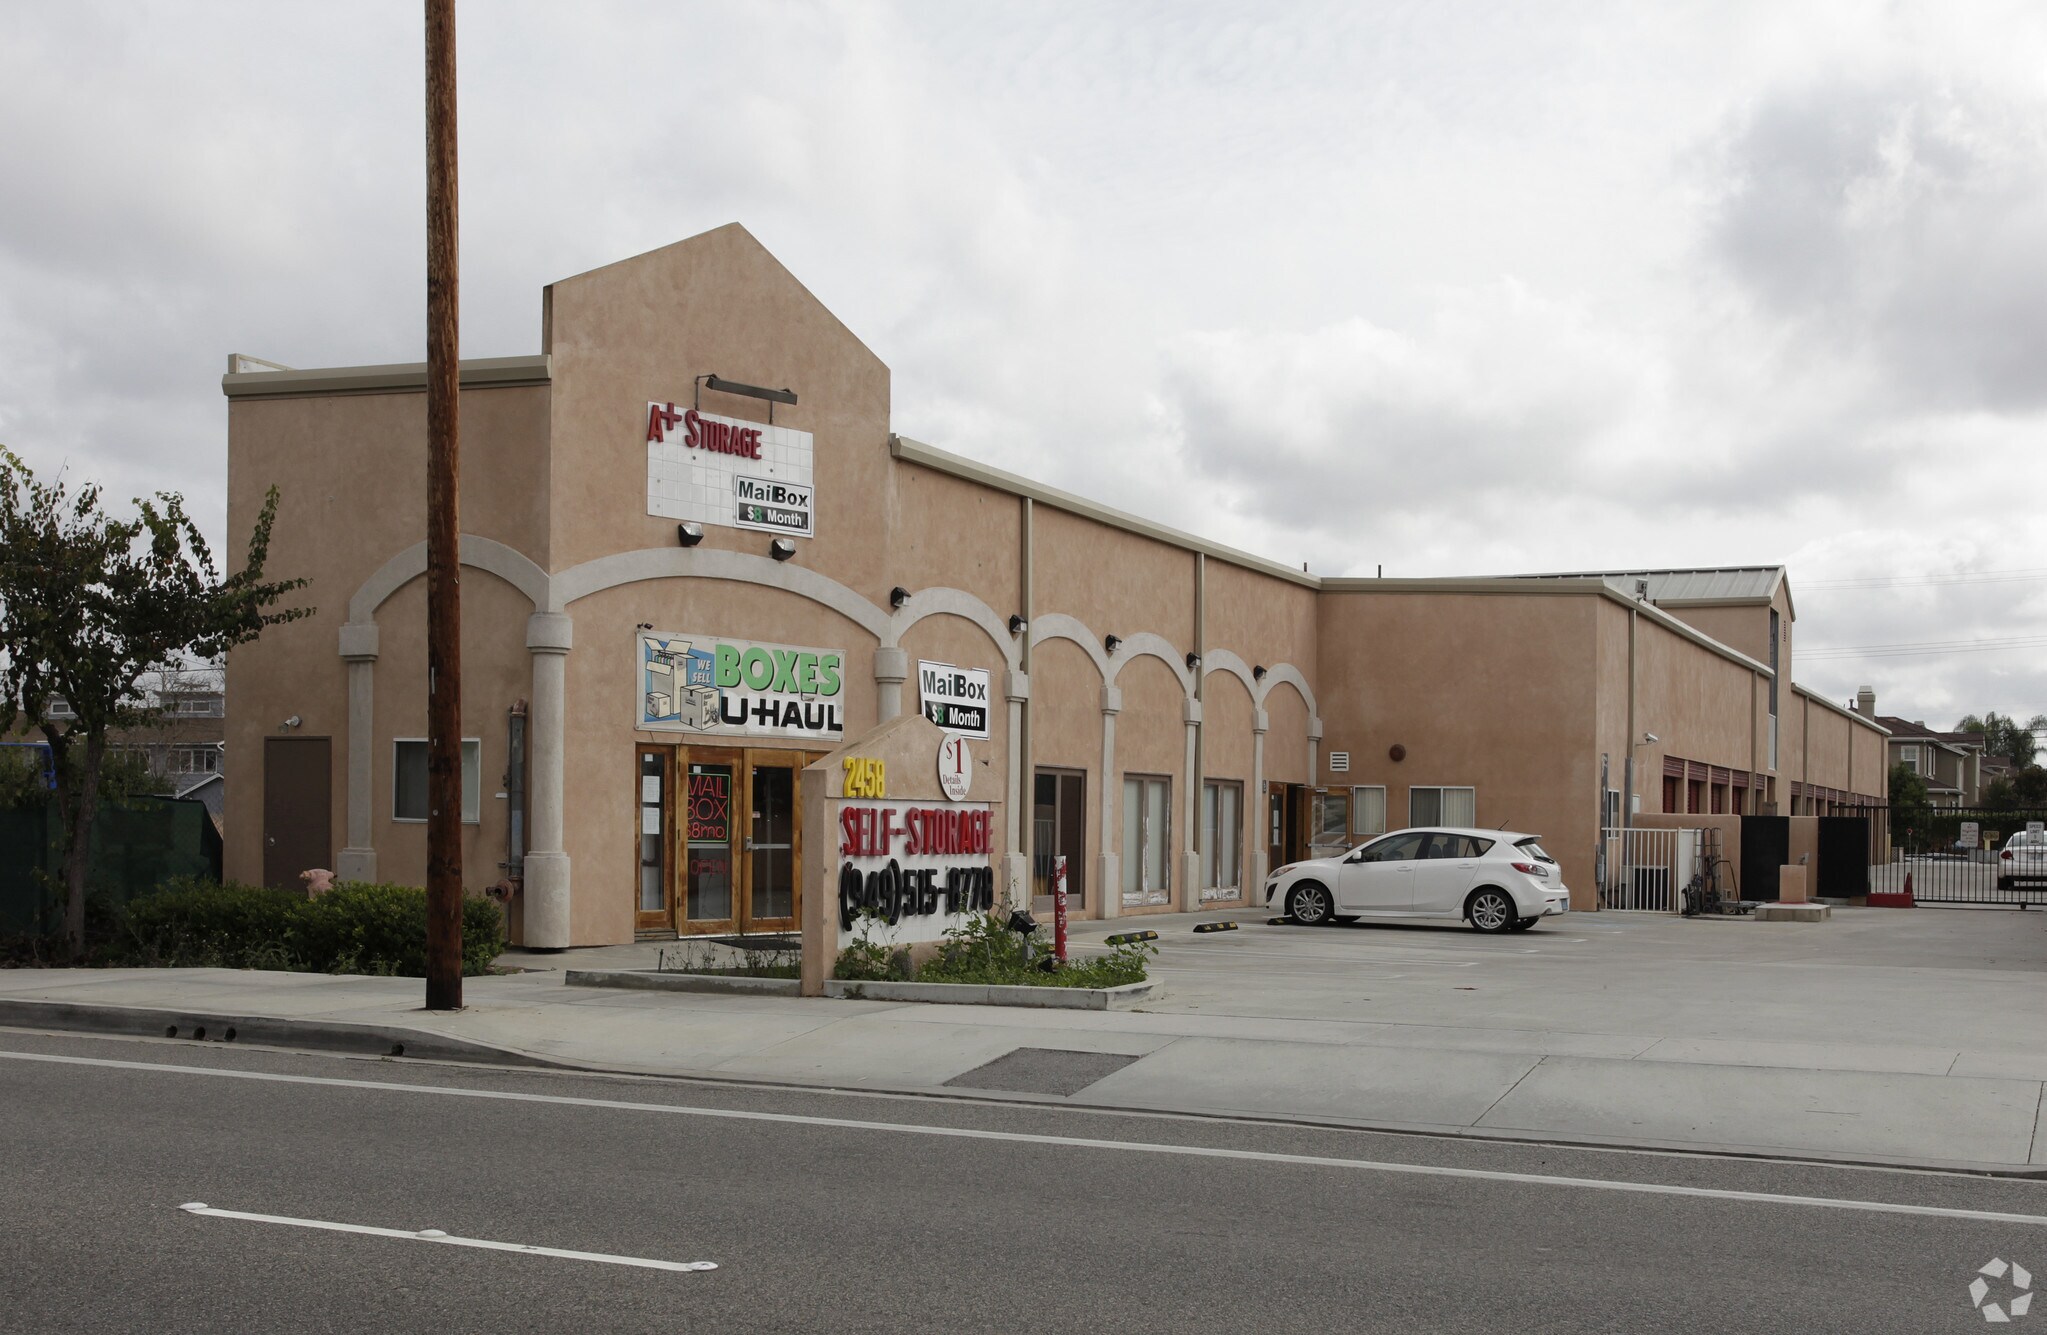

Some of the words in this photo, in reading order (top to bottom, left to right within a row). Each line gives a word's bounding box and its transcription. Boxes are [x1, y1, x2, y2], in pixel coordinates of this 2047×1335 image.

[647, 402, 682, 442] A+
[747, 505, 763, 523] $8
[767, 508, 802, 526] Month
[697, 659, 711, 671] WE
[715, 644, 841, 696] BOXES
[692, 672, 711, 684] SELL
[720, 696, 843, 731] U-HAUL
[932, 704, 945, 724] $8
[949, 707, 980, 727] Month
[843, 756, 885, 798] 2458
[942, 774, 962, 784] Details
[949, 785, 967, 796] Inside
[841, 806, 994, 856] SELF-STORAGE
